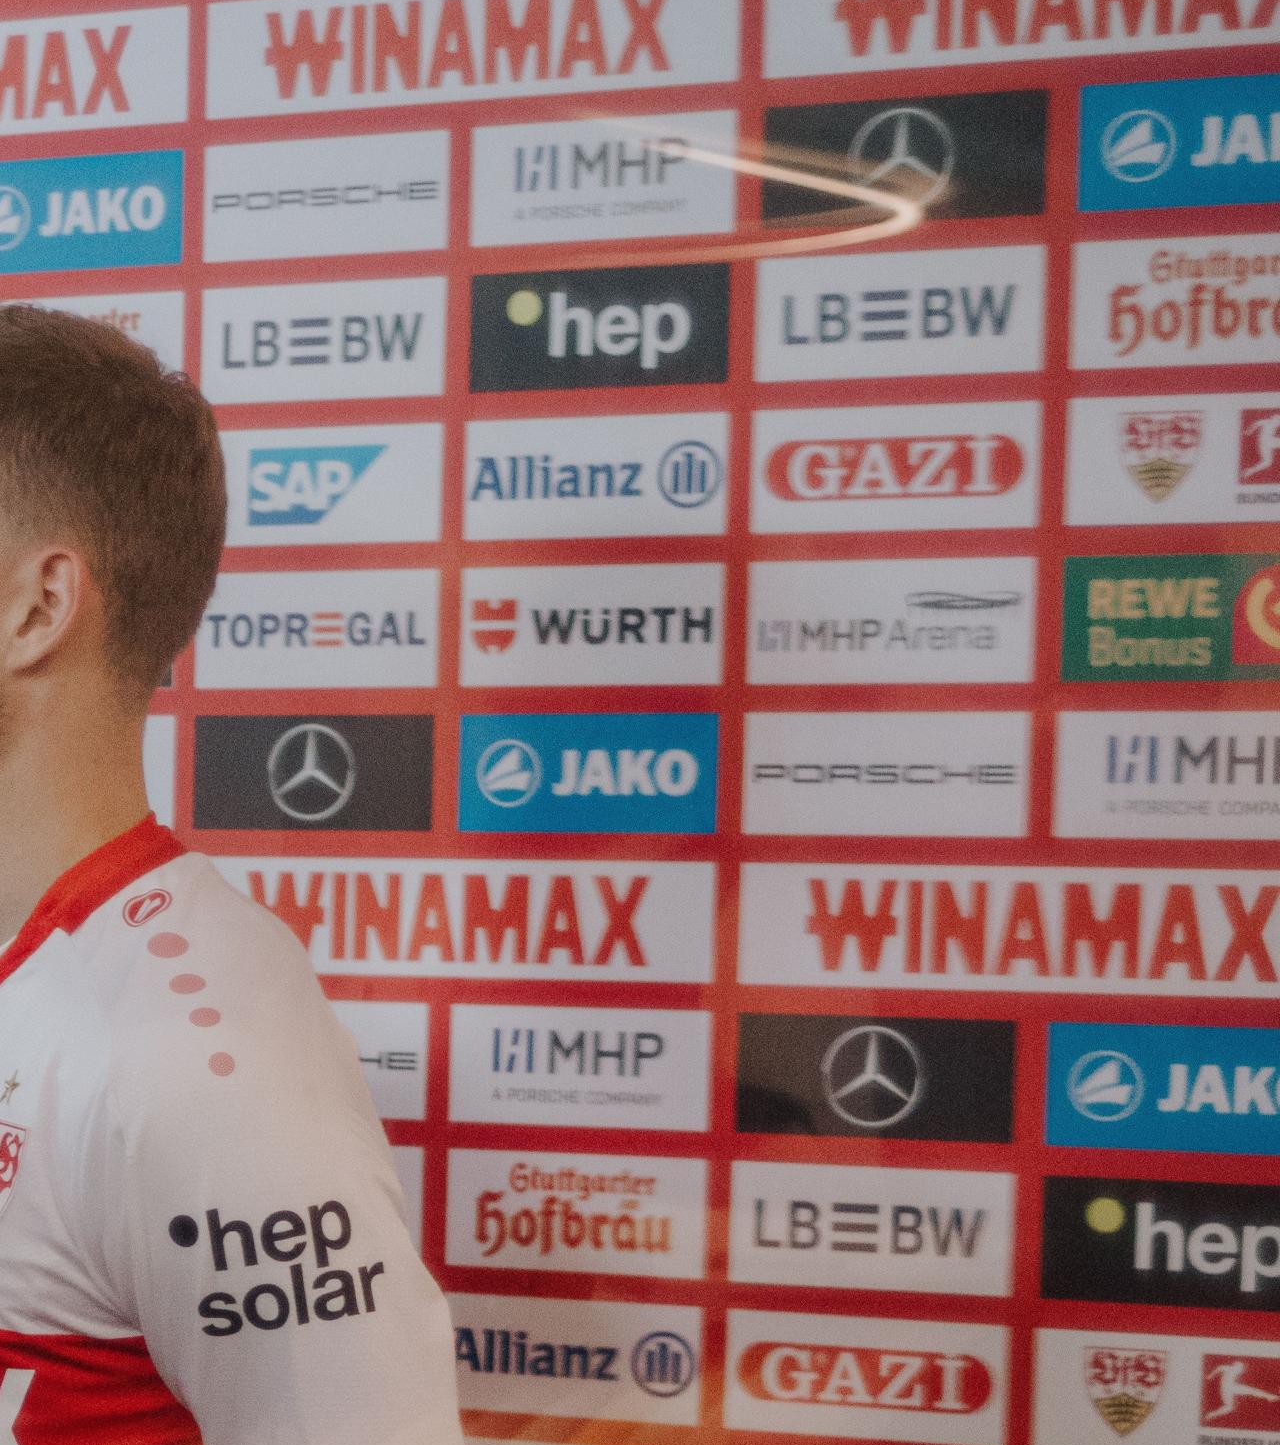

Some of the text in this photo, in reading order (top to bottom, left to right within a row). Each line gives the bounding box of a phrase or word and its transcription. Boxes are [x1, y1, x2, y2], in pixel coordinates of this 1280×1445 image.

[1191, 112, 1280, 168] JA
[40, 186, 165, 236] JAKO
[212, 180, 439, 213] PORSCHE
[547, 291, 692, 368] hep
[1108, 281, 1280, 357] Hofbr
[249, 460, 352, 512] SAP
[471, 455, 642, 501] Allianz
[788, 439, 1002, 496] GAZI
[1089, 579, 1221, 619] REWE
[1089, 627, 1211, 667] Bonus
[551, 749, 699, 797] JAKO
[753, 763, 1017, 785] PORSCHE
[1173, 735, 1280, 785] MH
[246, 870, 650, 967] WINAMAX
[807, 877, 1280, 983] WINAMAX
[550, 1032, 665, 1077] MHP
[1157, 1063, 1280, 1115] JAK
[207, 1199, 351, 1271] hep
[475, 1188, 671, 1256] Hofbräu
[1133, 1202, 1280, 1292] hep
[198, 1262, 384, 1337] solar
[453, 1327, 619, 1383] Allianz
[760, 1348, 969, 1411] GAZI
